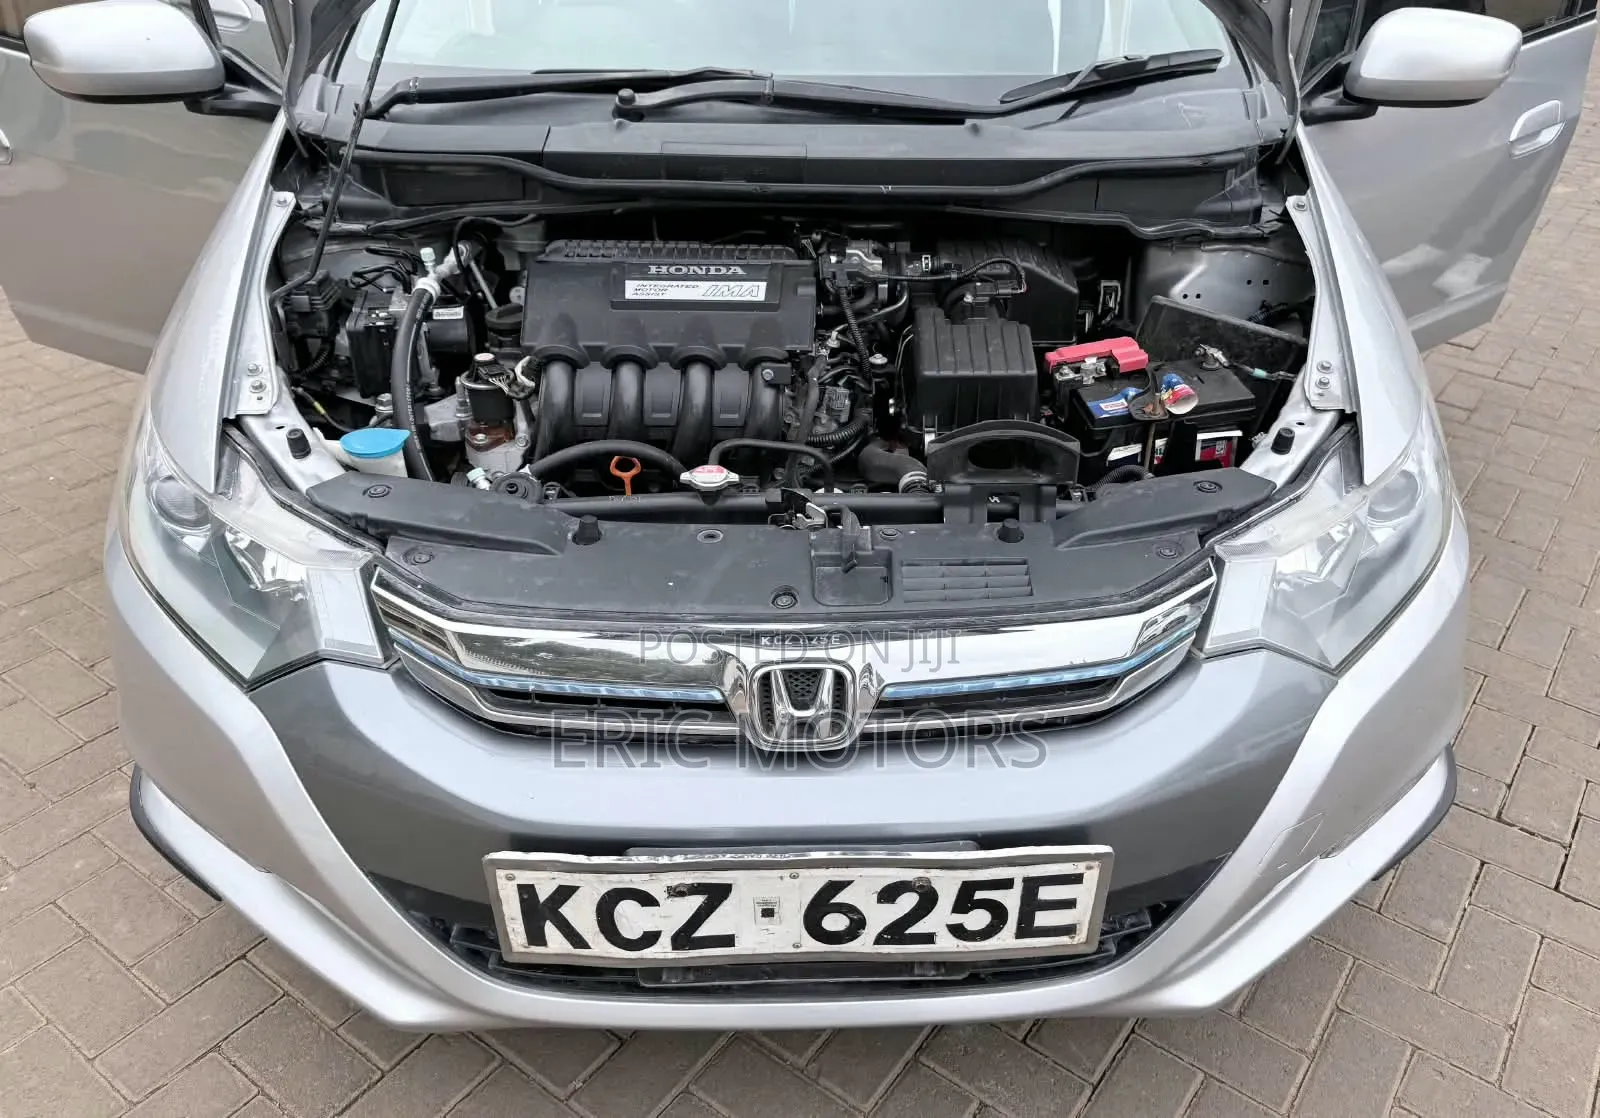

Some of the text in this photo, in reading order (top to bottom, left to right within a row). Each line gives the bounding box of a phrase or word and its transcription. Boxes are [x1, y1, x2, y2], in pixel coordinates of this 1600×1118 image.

[647, 265, 746, 275] HONDA
[702, 284, 759, 297] IMA
[517, 873, 1084, 951] KCZ 625E
